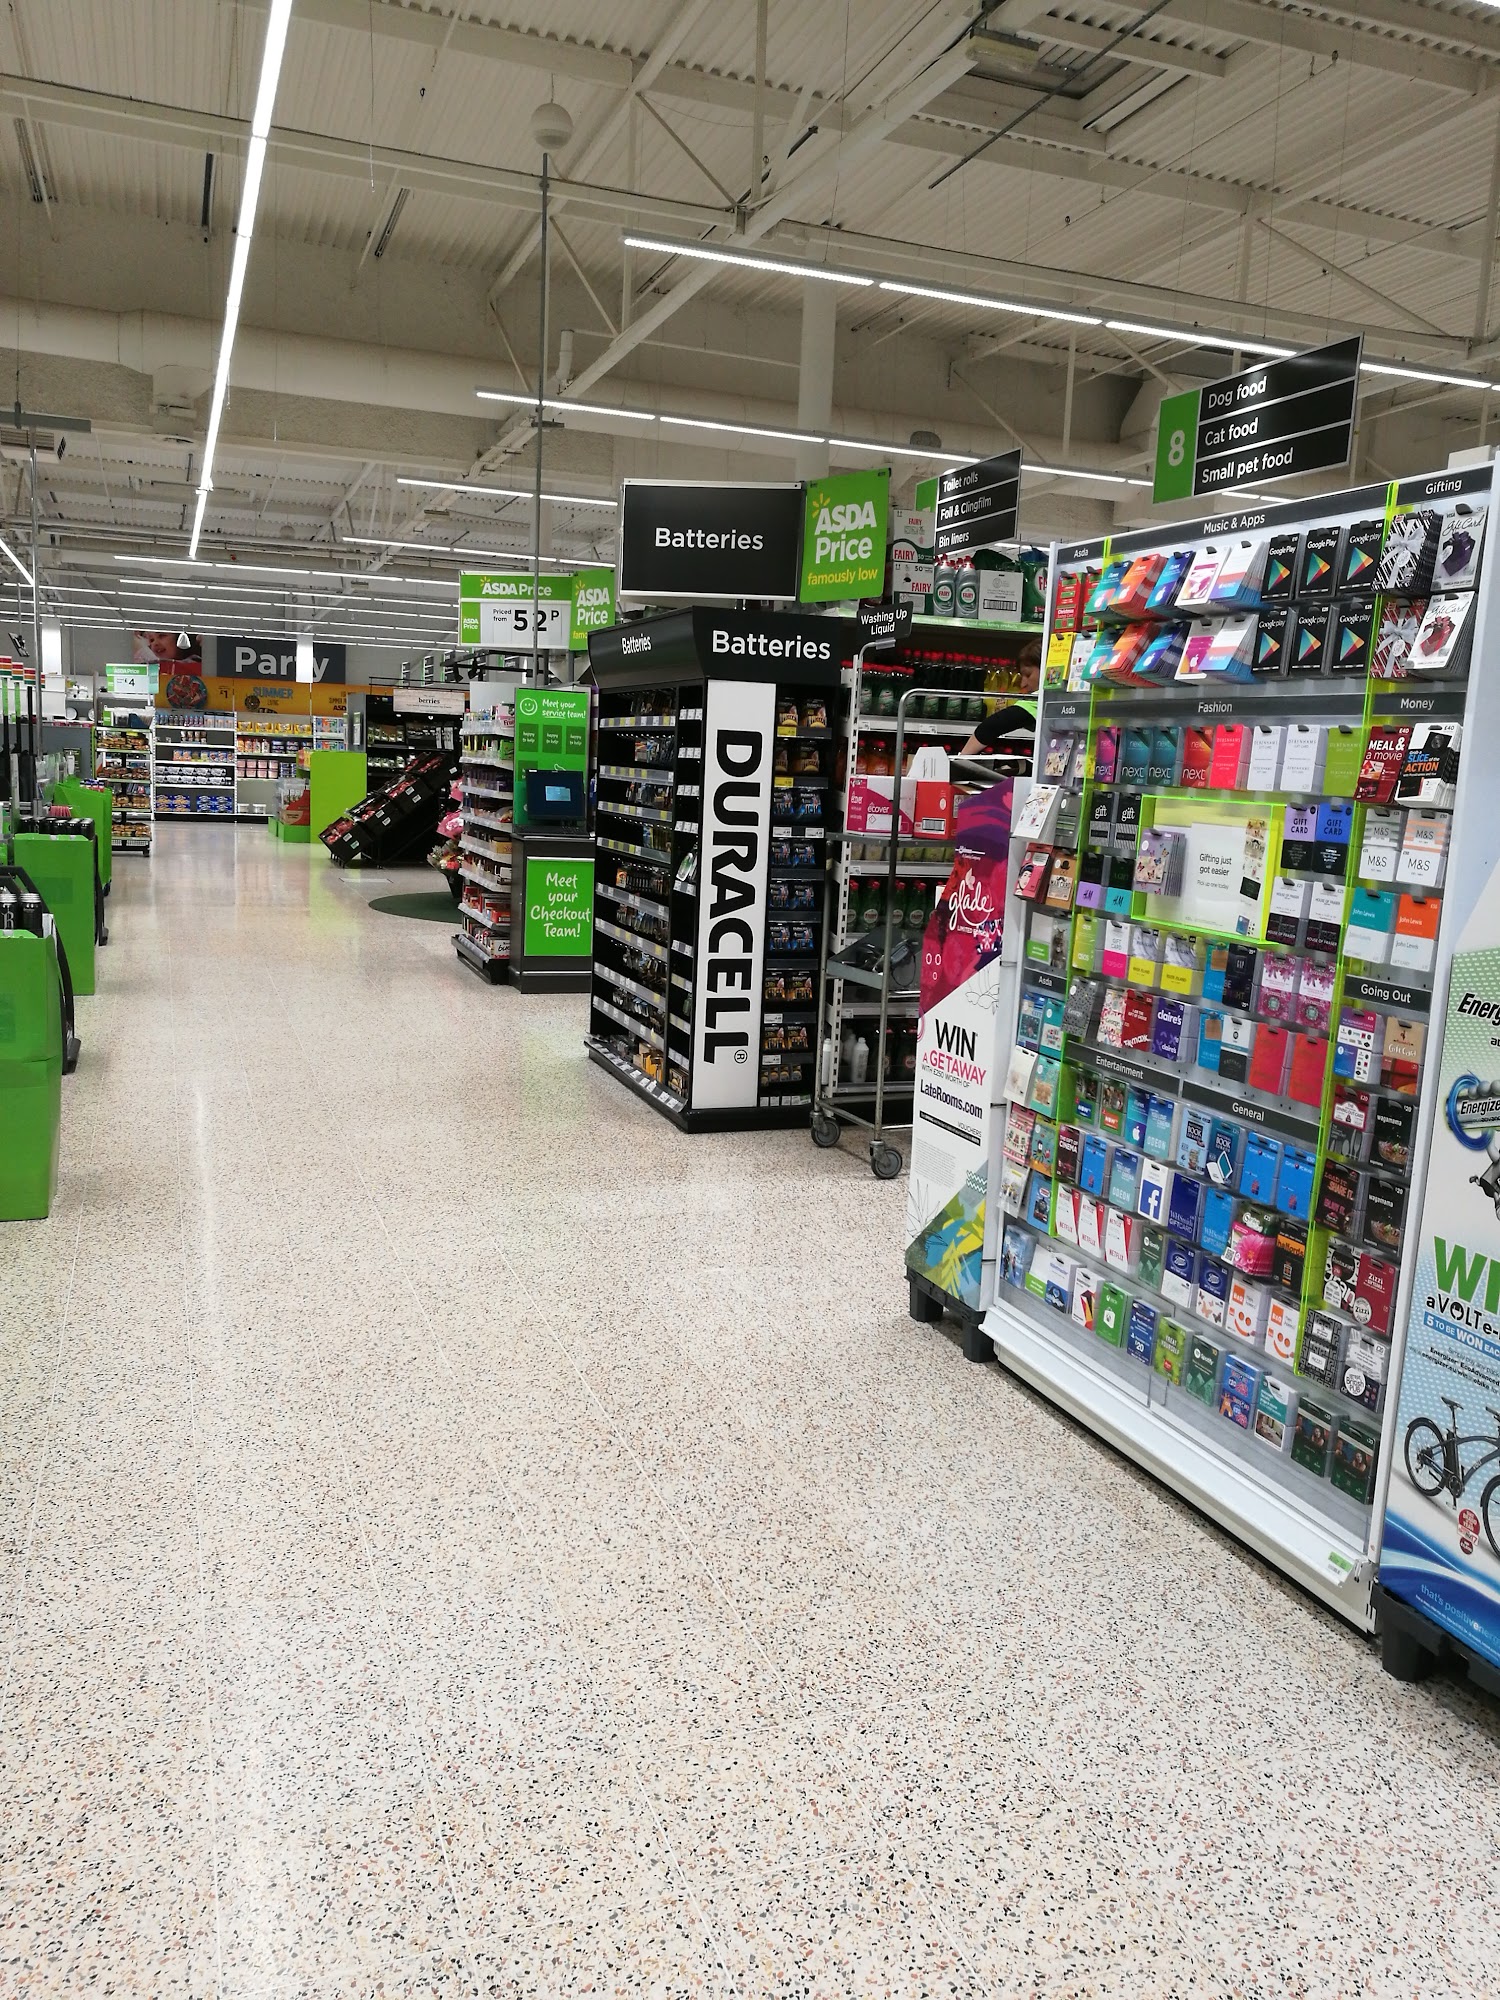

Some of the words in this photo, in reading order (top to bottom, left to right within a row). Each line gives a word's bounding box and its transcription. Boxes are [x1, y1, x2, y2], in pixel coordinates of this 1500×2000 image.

[1208, 390, 1233, 408] Dog
[1236, 376, 1267, 400] food
[1205, 428, 1225, 446] Cat
[1228, 417, 1258, 440] food
[1168, 430, 1185, 466] 8
[1202, 461, 1234, 483] Small
[1237, 457, 1258, 478] pet
[1262, 448, 1294, 470] food
[943, 478, 962, 492] Toilet
[963, 472, 978, 486] rolls
[1426, 478, 1462, 496] Gifting
[940, 506, 952, 520] Foil
[954, 504, 960, 516] &
[961, 496, 992, 514] Clingfilm
[815, 501, 877, 536] ASDA
[1204, 520, 1228, 534] Music
[1230, 519, 1238, 530] &
[1240, 514, 1265, 530] Apps
[1461, 515, 1485, 530] Card
[655, 527, 764, 550] Batteries
[938, 534, 950, 548] Bin
[951, 531, 970, 545] liners
[1308, 541, 1324, 549] Google
[1324, 539, 1336, 547] Play
[1350, 535, 1368, 544] Google
[1368, 533, 1381, 541] play
[816, 534, 873, 564] Price
[894, 549, 916, 561] FAIRY
[1074, 548, 1089, 558] Asda
[1270, 548, 1286, 556] Google
[808, 570, 855, 586] famously
[858, 568, 878, 581] low
[482, 582, 518, 596] ASDA
[518, 584, 552, 596] Price
[912, 582, 932, 592] FAIRY
[576, 587, 610, 607] ASDA
[962, 591, 974, 599] FAIRY
[493, 608, 512, 616] Priced
[1446, 602, 1466, 614] Card
[577, 609, 608, 626] Price
[860, 610, 894, 625] Washing
[896, 608, 908, 621] Up
[1299, 616, 1316, 625] Google
[1316, 615, 1327, 623] play
[1340, 615, 1357, 624] Google
[1358, 614, 1371, 622] play
[870, 622, 896, 636] Liquid
[622, 632, 652, 655] Batteries
[712, 630, 831, 660] Batteries
[235, 646, 329, 683] Pary
[252, 686, 293, 699] SUMMER
[542, 699, 559, 709] Meet
[1061, 706, 1076, 714] Asda
[1198, 702, 1233, 713] Fashion
[1400, 698, 1434, 711] Money
[1369, 740, 1395, 750] MEAL
[1395, 737, 1405, 750] &
[1374, 751, 1403, 760] movie
[1408, 754, 1429, 763] SLICE
[1096, 765, 1112, 775] next
[1122, 766, 1144, 778] next
[1149, 767, 1171, 778] next
[1182, 768, 1206, 780] next
[1405, 762, 1438, 773] ACTION
[868, 804, 889, 813] ecover
[1095, 805, 1107, 819] gift
[1122, 807, 1135, 821] gift
[1291, 826, 1308, 834] CARD
[1374, 828, 1389, 837] M&S
[1416, 830, 1434, 840] M&S
[1200, 854, 1220, 865] Gifting
[1222, 856, 1232, 865] just
[1368, 856, 1387, 867] M&S
[1408, 859, 1431, 871] M&S
[1200, 866, 1209, 875] got
[1210, 867, 1229, 877] easier
[546, 872, 577, 888] Meet
[548, 890, 578, 904] your
[704, 729, 763, 1064] DURACELL
[949, 880, 994, 930] glade
[530, 904, 591, 922] Checkout
[1353, 908, 1362, 916] John
[1399, 916, 1409, 924] John
[543, 922, 581, 938] Team!
[1396, 940, 1405, 948] John
[1038, 976, 1052, 986] Asda
[1361, 984, 1389, 1000] Going
[1393, 990, 1411, 1003] Out
[1157, 1010, 1182, 1025] claire's
[935, 1019, 976, 1061] WIN
[1162, 1044, 1176, 1053] claire's
[1389, 1044, 1400, 1054] Gift
[1402, 1047, 1416, 1056] Card
[922, 1055, 928, 1063] A
[930, 1050, 987, 1086] GETAWAY
[1096, 1055, 1144, 1079] Entertainment
[921, 1065, 933, 1073] WITH
[934, 1068, 944, 1079] £250
[945, 1074, 962, 1086] WORTH
[920, 1079, 983, 1119] LateRooms.com
[1232, 1102, 1265, 1121] General
[1377, 1115, 1402, 1126] wagamama
[958, 1121, 982, 1137] VOUCHERS
[1188, 1126, 1202, 1136] BOOK
[1060, 1141, 1078, 1153] CINEMA
[1147, 1136, 1166, 1150] ODEON
[1216, 1136, 1231, 1148] BOOK
[1113, 1186, 1130, 1201] ODEON
[1369, 1194, 1394, 1207] wagamama
[1170, 1210, 1193, 1227] WHSmith
[1060, 1222, 1072, 1233] NETFLIX
[1169, 1218, 1192, 1233] GIFTCARD
[1082, 1234, 1096, 1246] NETFLIX
[1204, 1227, 1226, 1243] WHSmith
[1109, 1249, 1124, 1261] NETFLIX
[1278, 1242, 1305, 1258] halfords
[1369, 1272, 1384, 1285] Zizzi
[1355, 1307, 1370, 1315] Zizzi
[1426, 1316, 1434, 1326] 5
[1436, 1321, 1444, 1330] TO
[1446, 1325, 1455, 1335] BE
[1456, 1328, 1484, 1350] WON
[1134, 1340, 1144, 1352] £20
[1165, 1336, 1177, 1346] TREAT
[1161, 1341, 1180, 1355] YOURSELF
[1201, 1354, 1213, 1366] Spotify
[1460, 1361, 1500, 1386] EcoAdvanced
[1421, 1584, 1443, 1605] that's
